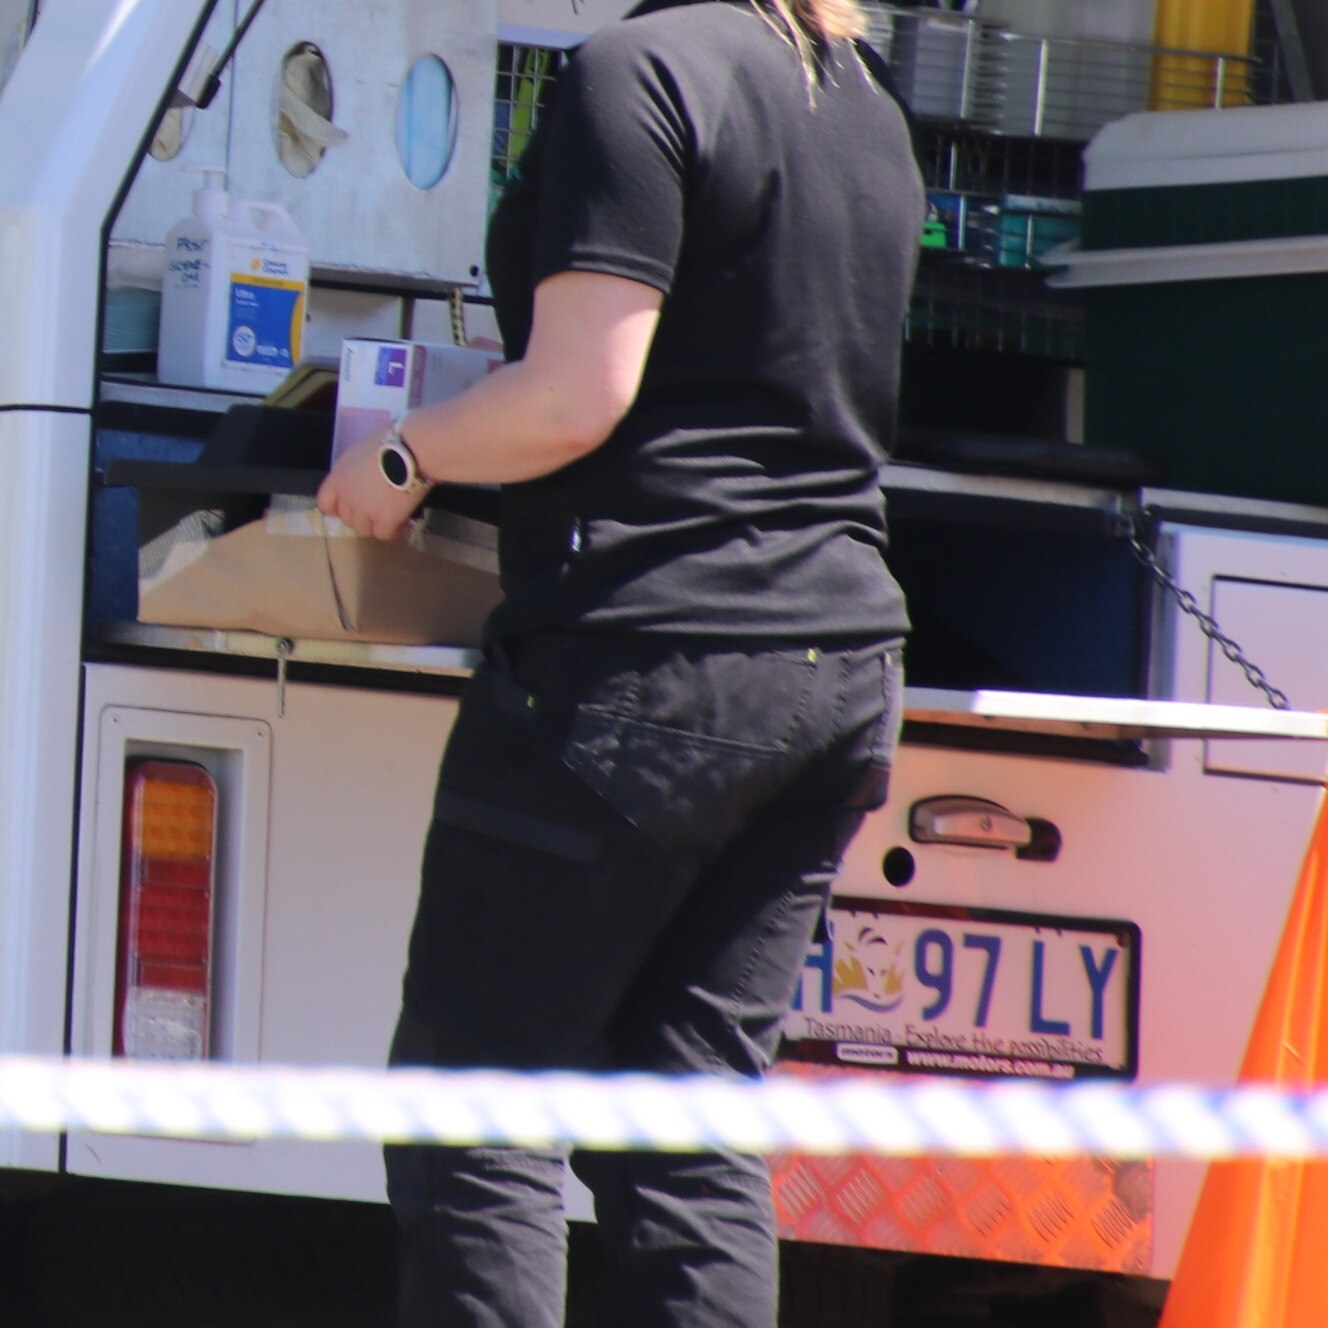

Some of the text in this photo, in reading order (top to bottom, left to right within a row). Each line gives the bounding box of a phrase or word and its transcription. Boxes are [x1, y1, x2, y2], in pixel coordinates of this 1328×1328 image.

[914, 929, 1002, 1028] 97
[1030, 939, 1119, 1040] LY
[804, 1016, 1104, 1062] Tasmania Explore the possibilities
